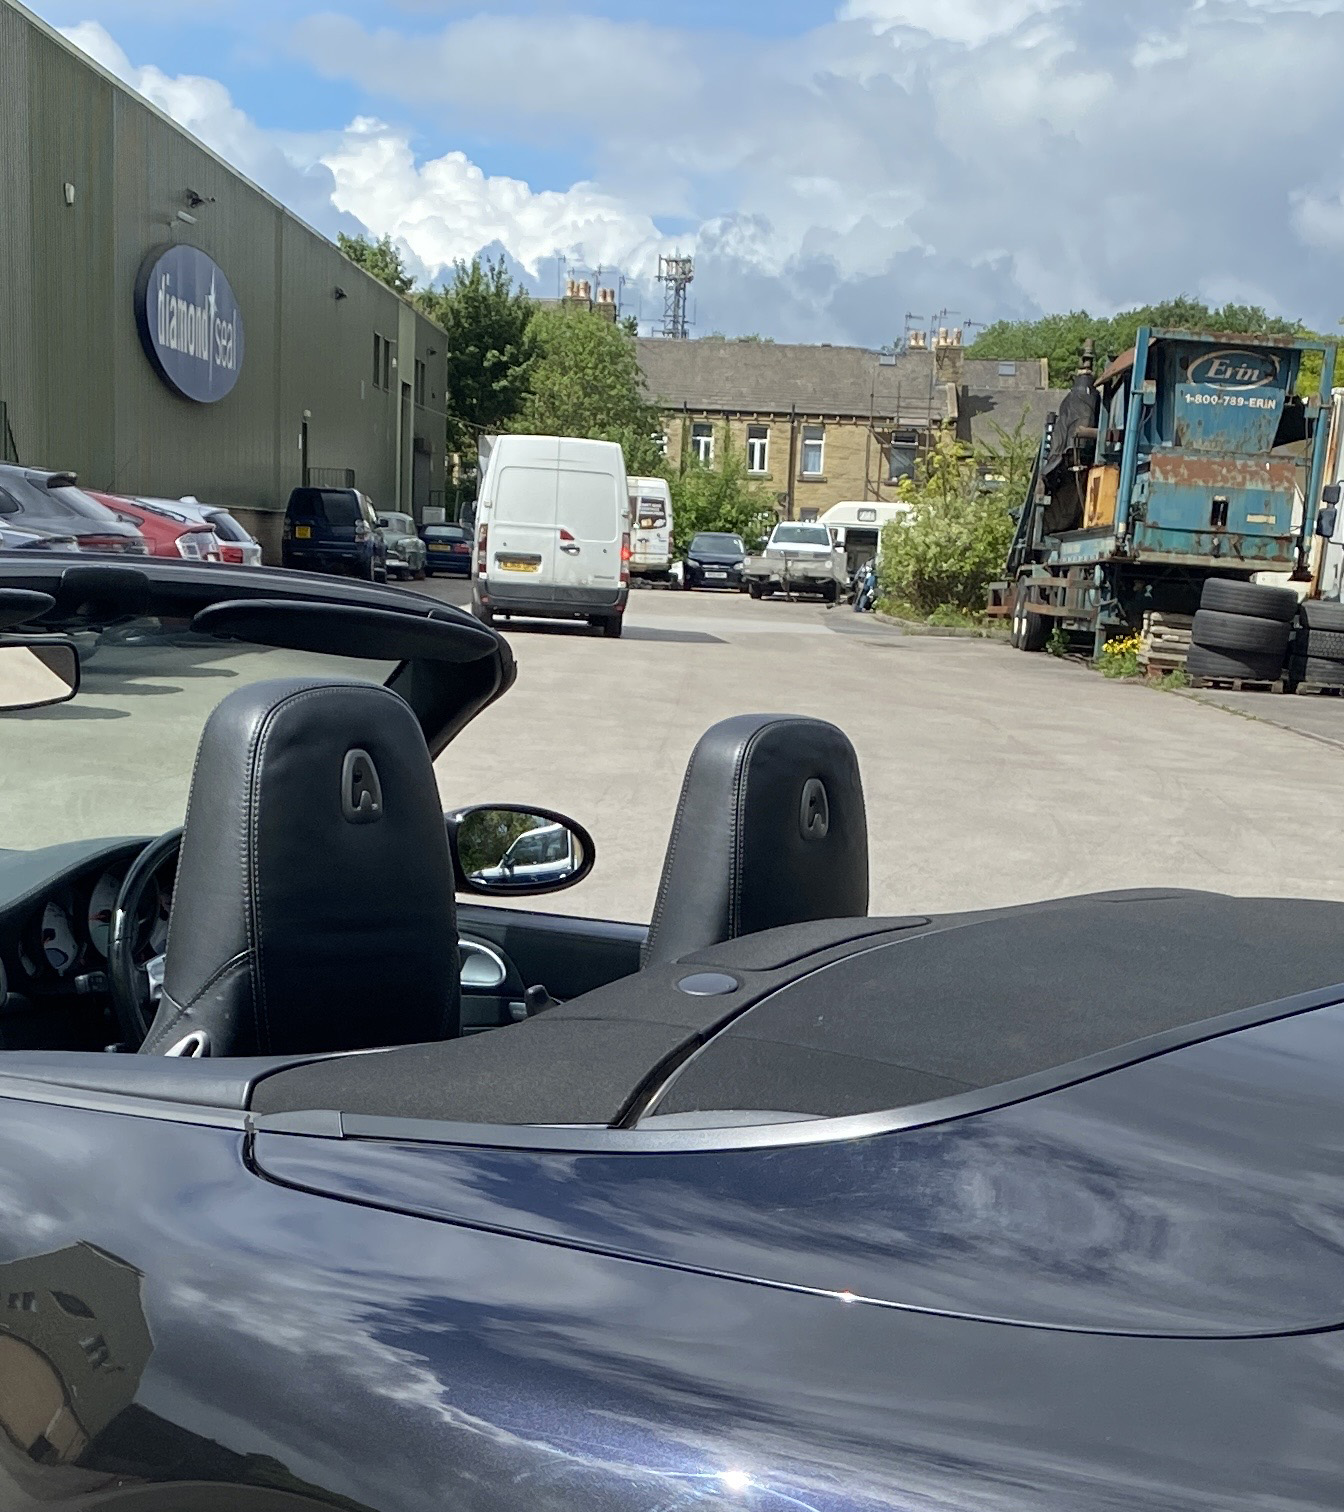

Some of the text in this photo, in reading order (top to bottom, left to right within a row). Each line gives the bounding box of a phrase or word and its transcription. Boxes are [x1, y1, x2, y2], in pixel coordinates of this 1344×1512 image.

[158, 272, 236, 371] diamond seal
[1205, 359, 1260, 381] Erin
[1185, 393, 1276, 409] 1-800-789-ERIN
